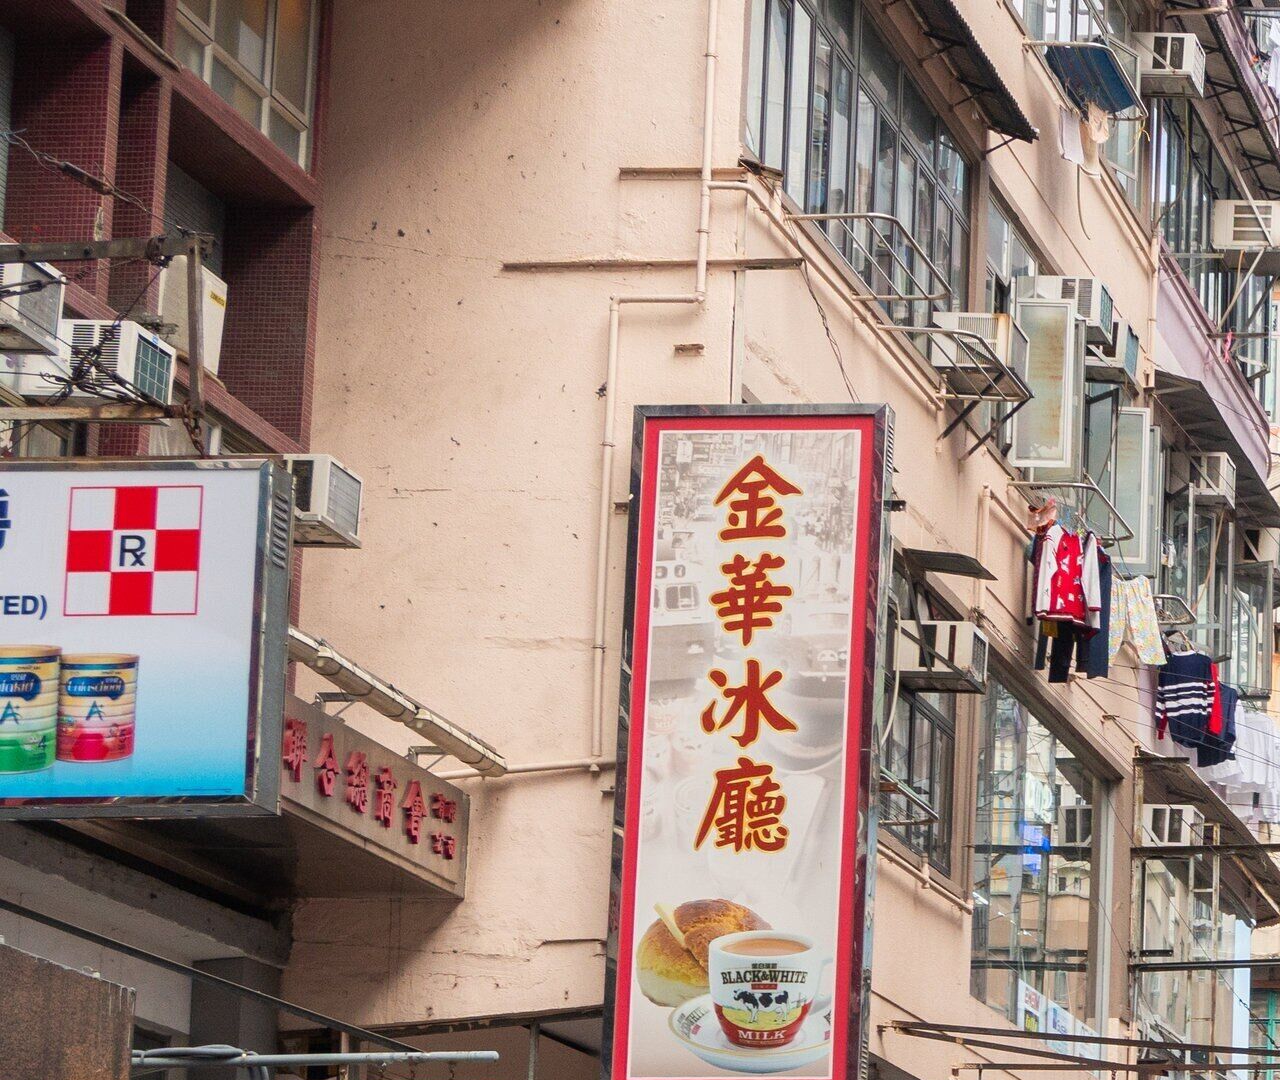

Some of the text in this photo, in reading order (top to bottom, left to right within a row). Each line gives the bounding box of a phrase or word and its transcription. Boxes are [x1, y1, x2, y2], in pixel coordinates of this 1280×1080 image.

[695, 454, 803, 854] 金華冰廳
[738, 1030, 785, 1039] MILK
